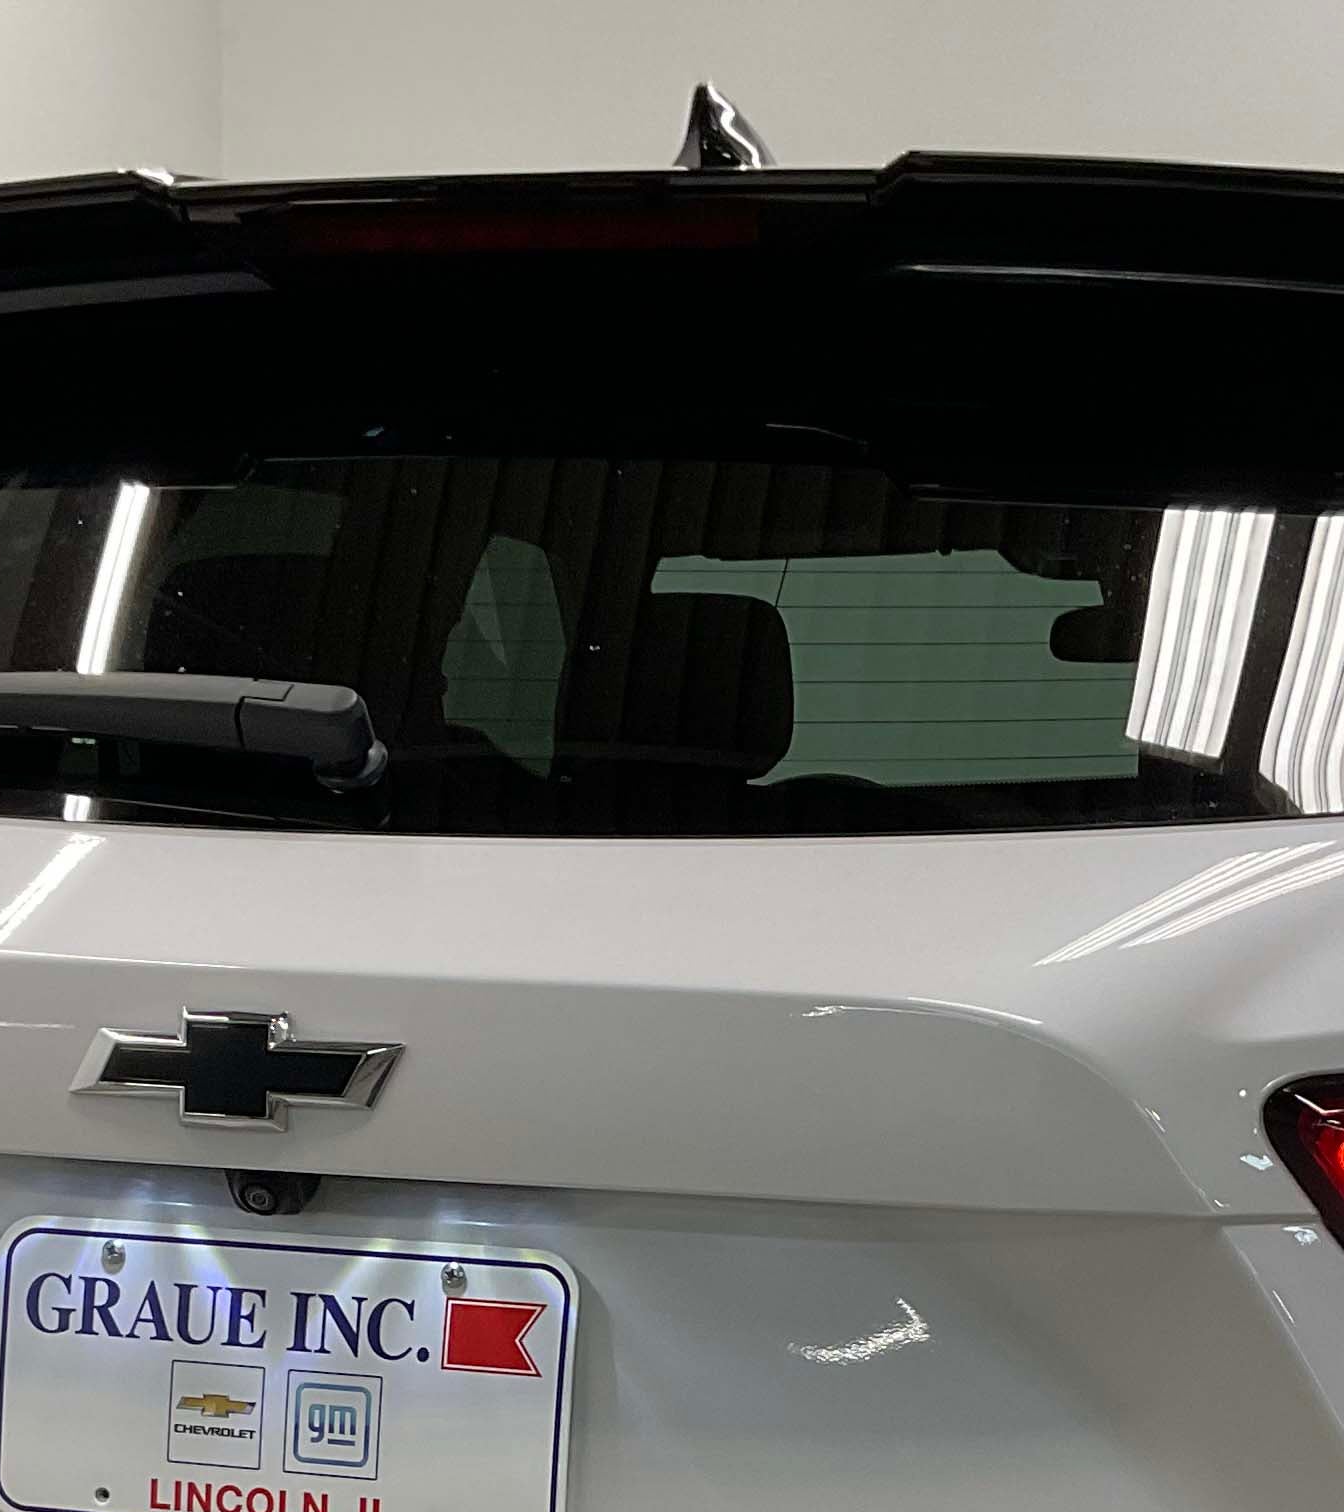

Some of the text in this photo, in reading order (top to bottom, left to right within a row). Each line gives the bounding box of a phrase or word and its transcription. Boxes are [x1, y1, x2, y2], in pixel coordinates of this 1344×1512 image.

[26, 1272, 430, 1362] GRAUE INC.
[174, 1423, 256, 1440] CHEVROLET
[308, 1403, 357, 1446] gm
